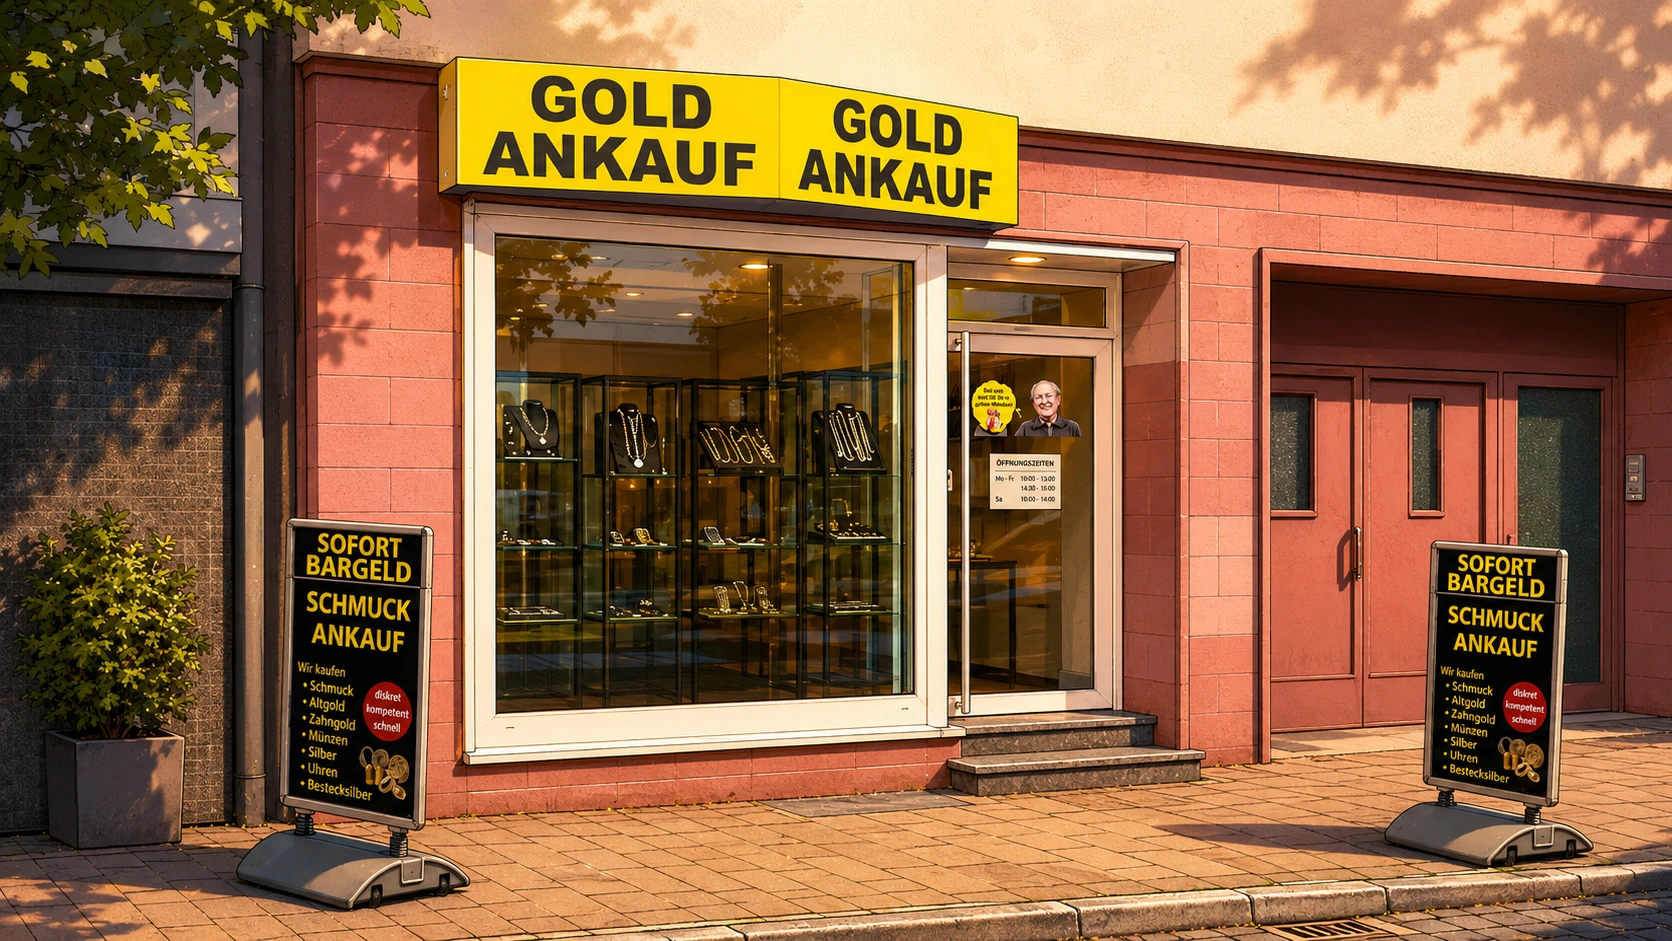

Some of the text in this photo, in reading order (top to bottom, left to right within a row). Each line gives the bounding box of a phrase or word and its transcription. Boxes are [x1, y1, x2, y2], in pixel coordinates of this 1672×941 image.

[532, 75, 712, 129] GOLD
[833, 98, 963, 155] GOLD
[482, 131, 756, 186] ANKAUF
[798, 148, 992, 210] ANKAUF
[996, 459, 1055, 467] ÖFFNUNGSZEITEN
[317, 533, 402, 558] SOFORT
[306, 554, 412, 583] BARGELD
[1458, 554, 1536, 576] SOFORT
[1448, 573, 1545, 598] BARGELD
[306, 591, 411, 621] SCHMUCK
[1448, 606, 1544, 632] SCHMUCK
[311, 623, 405, 652] ANKAUF
[1453, 633, 1538, 659] ANKAUF
[298, 662, 346, 677] Wir kaufen
[1441, 666, 1484, 680] Wir kaufen
[310, 681, 354, 697] Schmuck
[374, 690, 401, 703] diskret
[1452, 682, 1493, 695] Schmuck
[309, 697, 345, 712] Altgold
[1451, 695, 1486, 710] Altgold
[366, 706, 409, 720] kompetent
[1451, 709, 1496, 725] Zahngold
[309, 713, 356, 730] Zahngold
[373, 721, 401, 732] schnell
[309, 731, 348, 746] Münzen
[1451, 723, 1488, 738] Münzen
[1450, 736, 1477, 749] Silber
[308, 746, 337, 761] Silber
[1450, 750, 1478, 764] Uhren
[308, 763, 338, 777] Uhren
[1449, 764, 1510, 783] Bestecksilber
[308, 780, 373, 801] Bestecksilber
